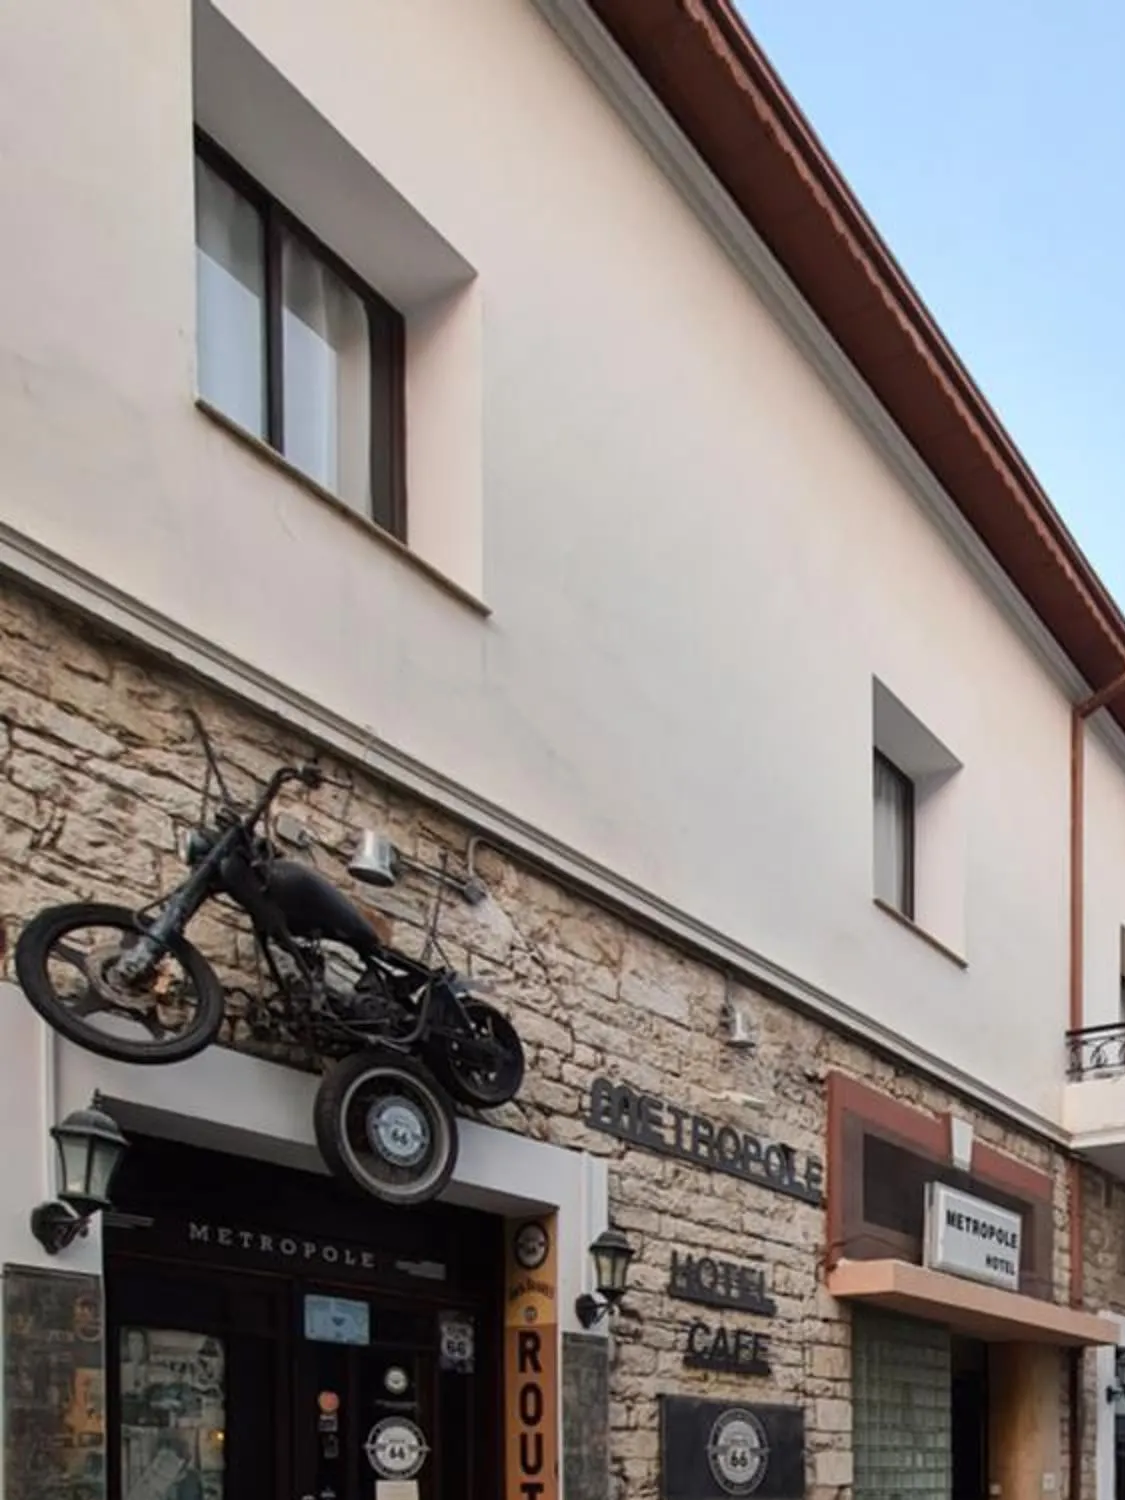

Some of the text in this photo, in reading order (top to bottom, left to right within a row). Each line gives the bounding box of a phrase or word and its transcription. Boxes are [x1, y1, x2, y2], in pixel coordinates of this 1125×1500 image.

[189, 1222, 376, 1268] METROPOLE
[946, 1209, 1017, 1249] METROPOLE
[668, 1249, 776, 1317] HOTEL
[985, 1253, 1015, 1276] HOTEL
[682, 1321, 772, 1377] CAFE
